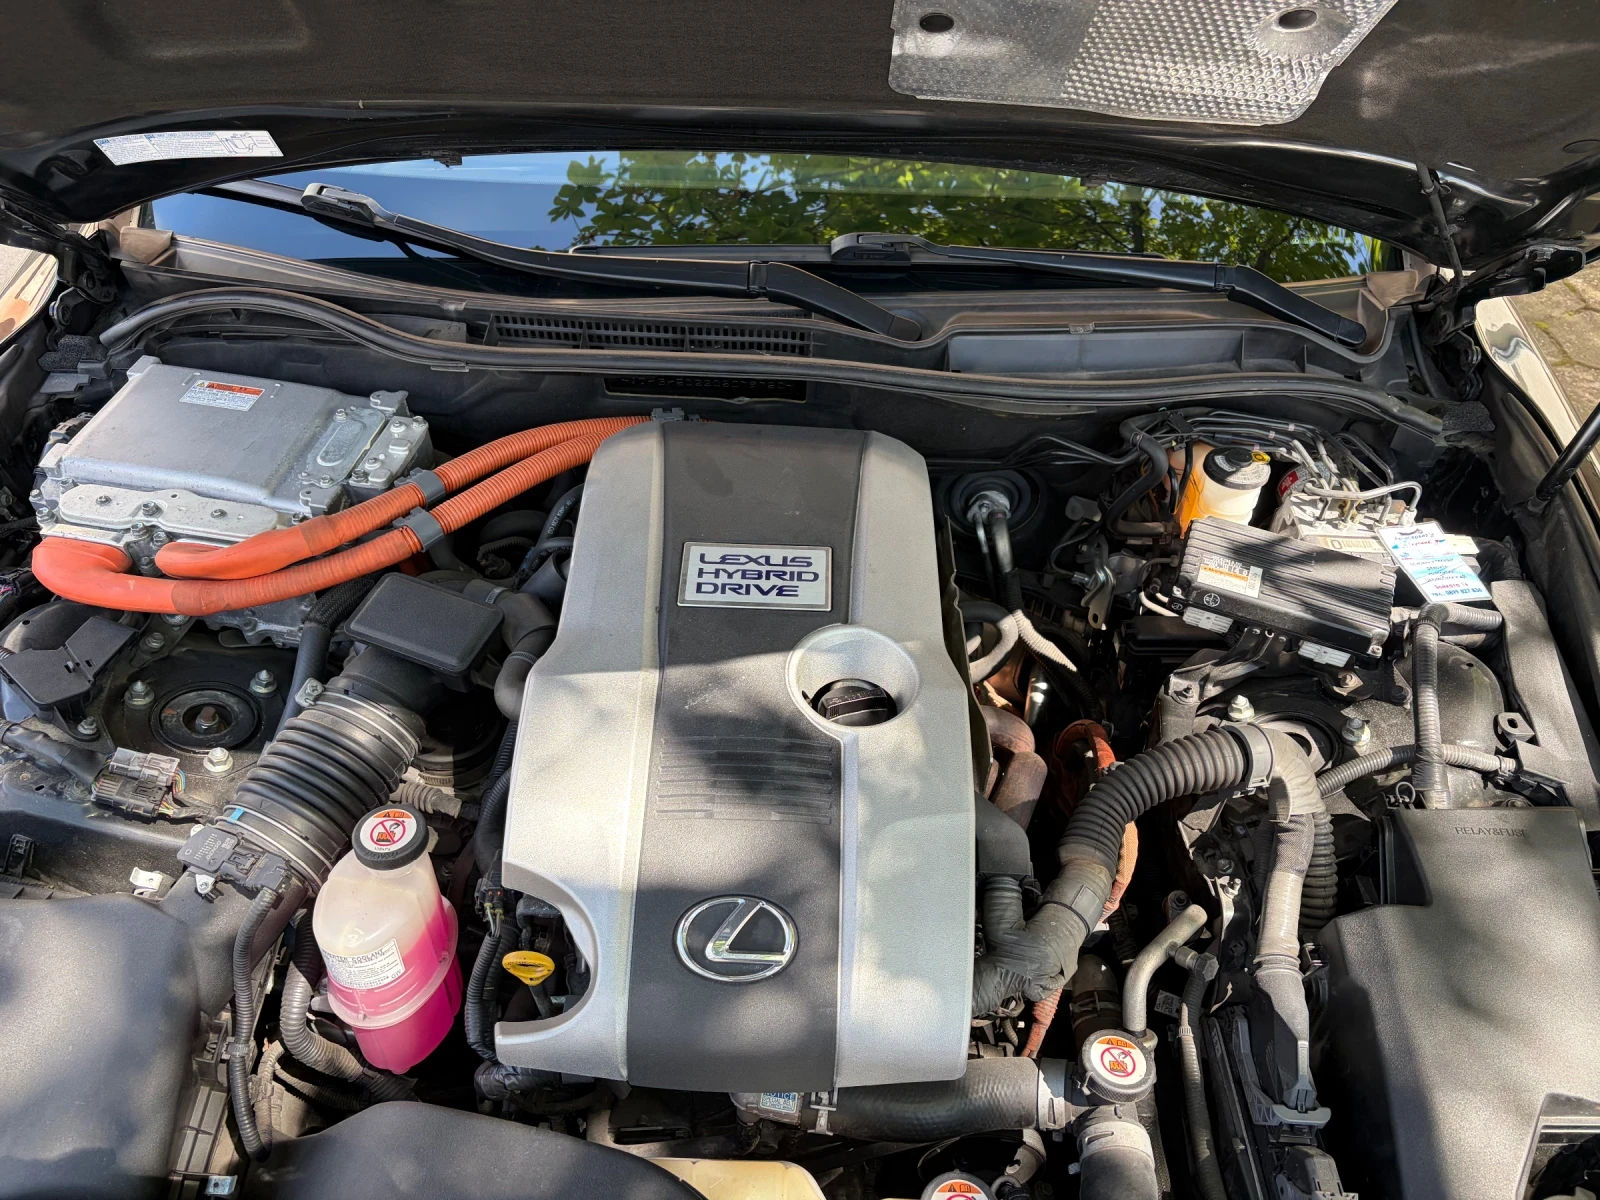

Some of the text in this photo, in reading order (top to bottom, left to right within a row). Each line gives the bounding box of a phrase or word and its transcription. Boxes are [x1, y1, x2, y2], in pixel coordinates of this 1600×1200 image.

[699, 553, 813, 568] LEXUS
[697, 568, 820, 582] HYBRID
[695, 582, 800, 597] DRIVE
[205, 840, 222, 860] DENSO
[352, 949, 384, 962] COOLANT
